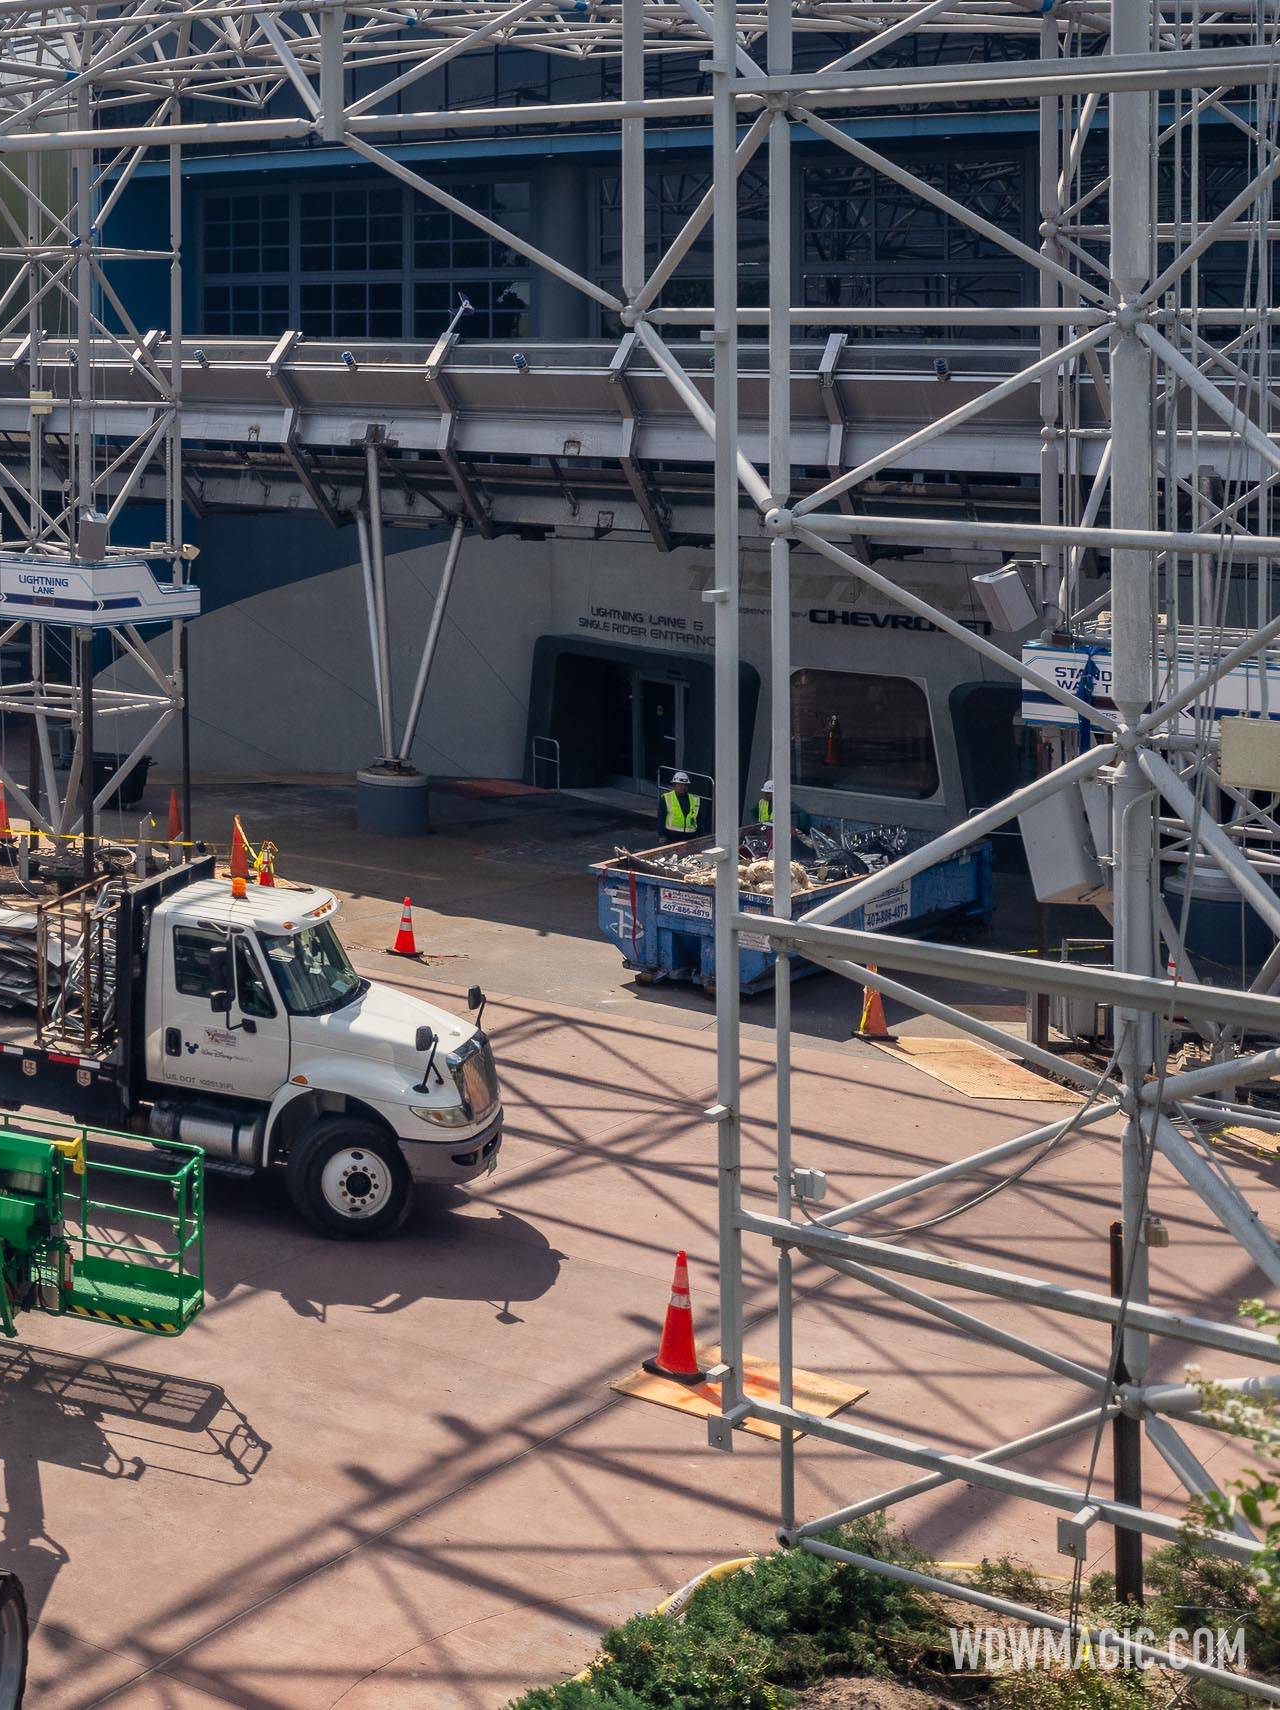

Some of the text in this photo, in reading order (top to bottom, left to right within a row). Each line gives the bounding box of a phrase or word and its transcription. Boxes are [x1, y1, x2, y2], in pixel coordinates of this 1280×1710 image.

[18, 574, 69, 588] LIGHTNING
[32, 585, 55, 595] LANE
[591, 606, 643, 623] LIGHTNING
[649, 615, 686, 629] LANE
[809, 608, 994, 636] CHEVROET
[578, 617, 716, 647] SINGLE RIDER ENTRANC
